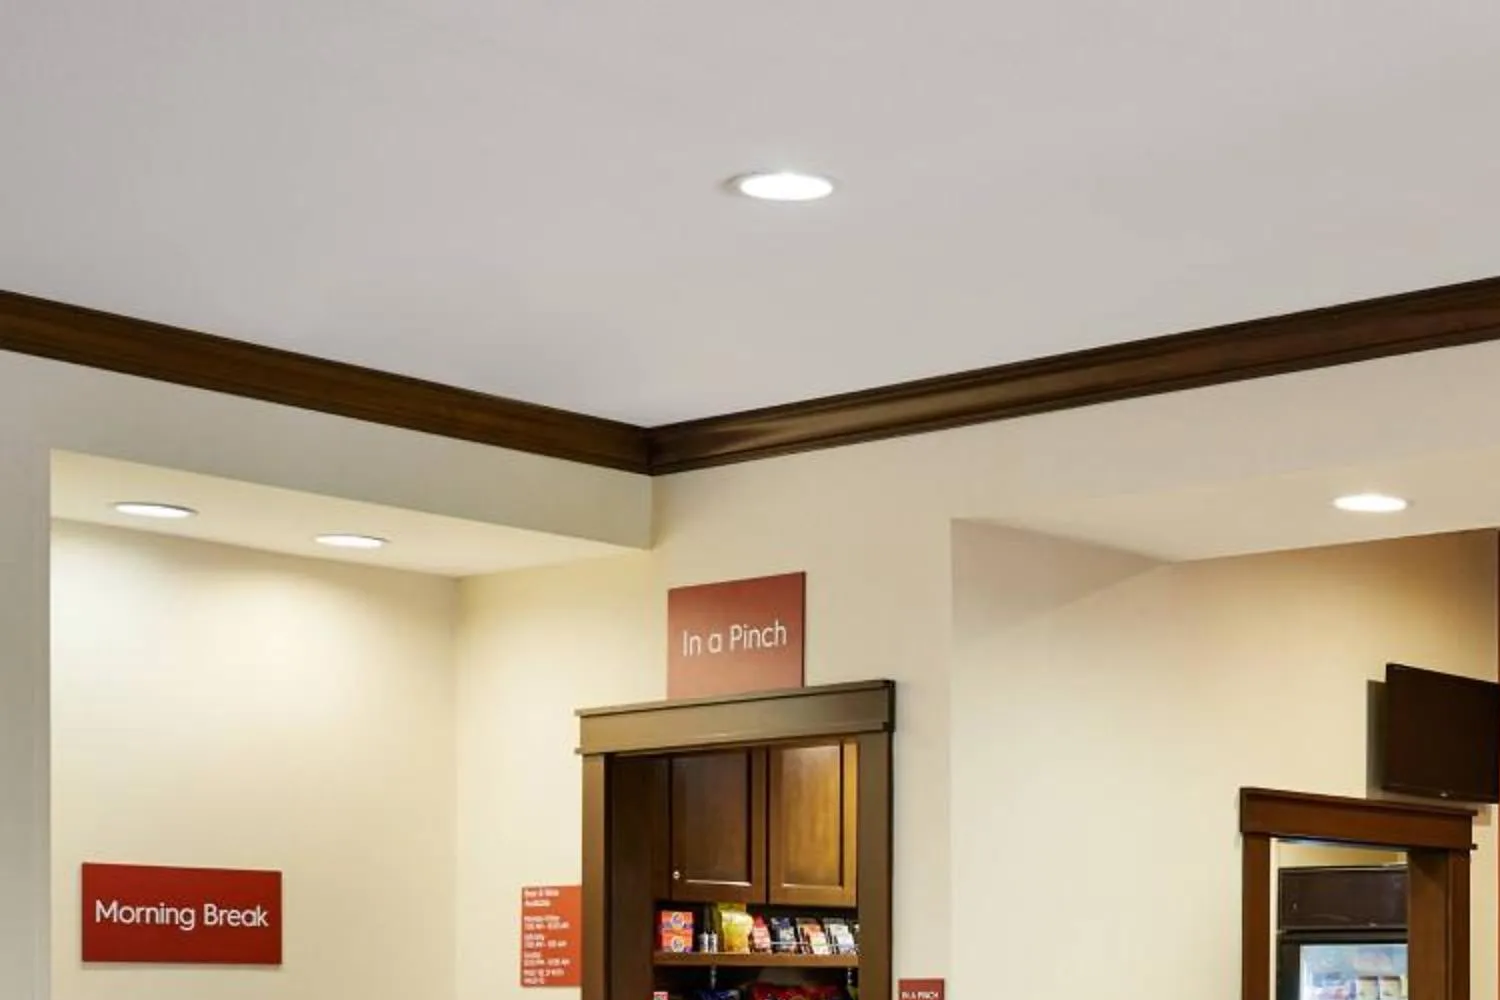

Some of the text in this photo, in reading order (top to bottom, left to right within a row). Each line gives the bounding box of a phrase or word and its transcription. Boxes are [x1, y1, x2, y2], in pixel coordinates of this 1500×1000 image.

[682, 618, 787, 657] In a Pinch
[95, 899, 269, 931] Morning Break
